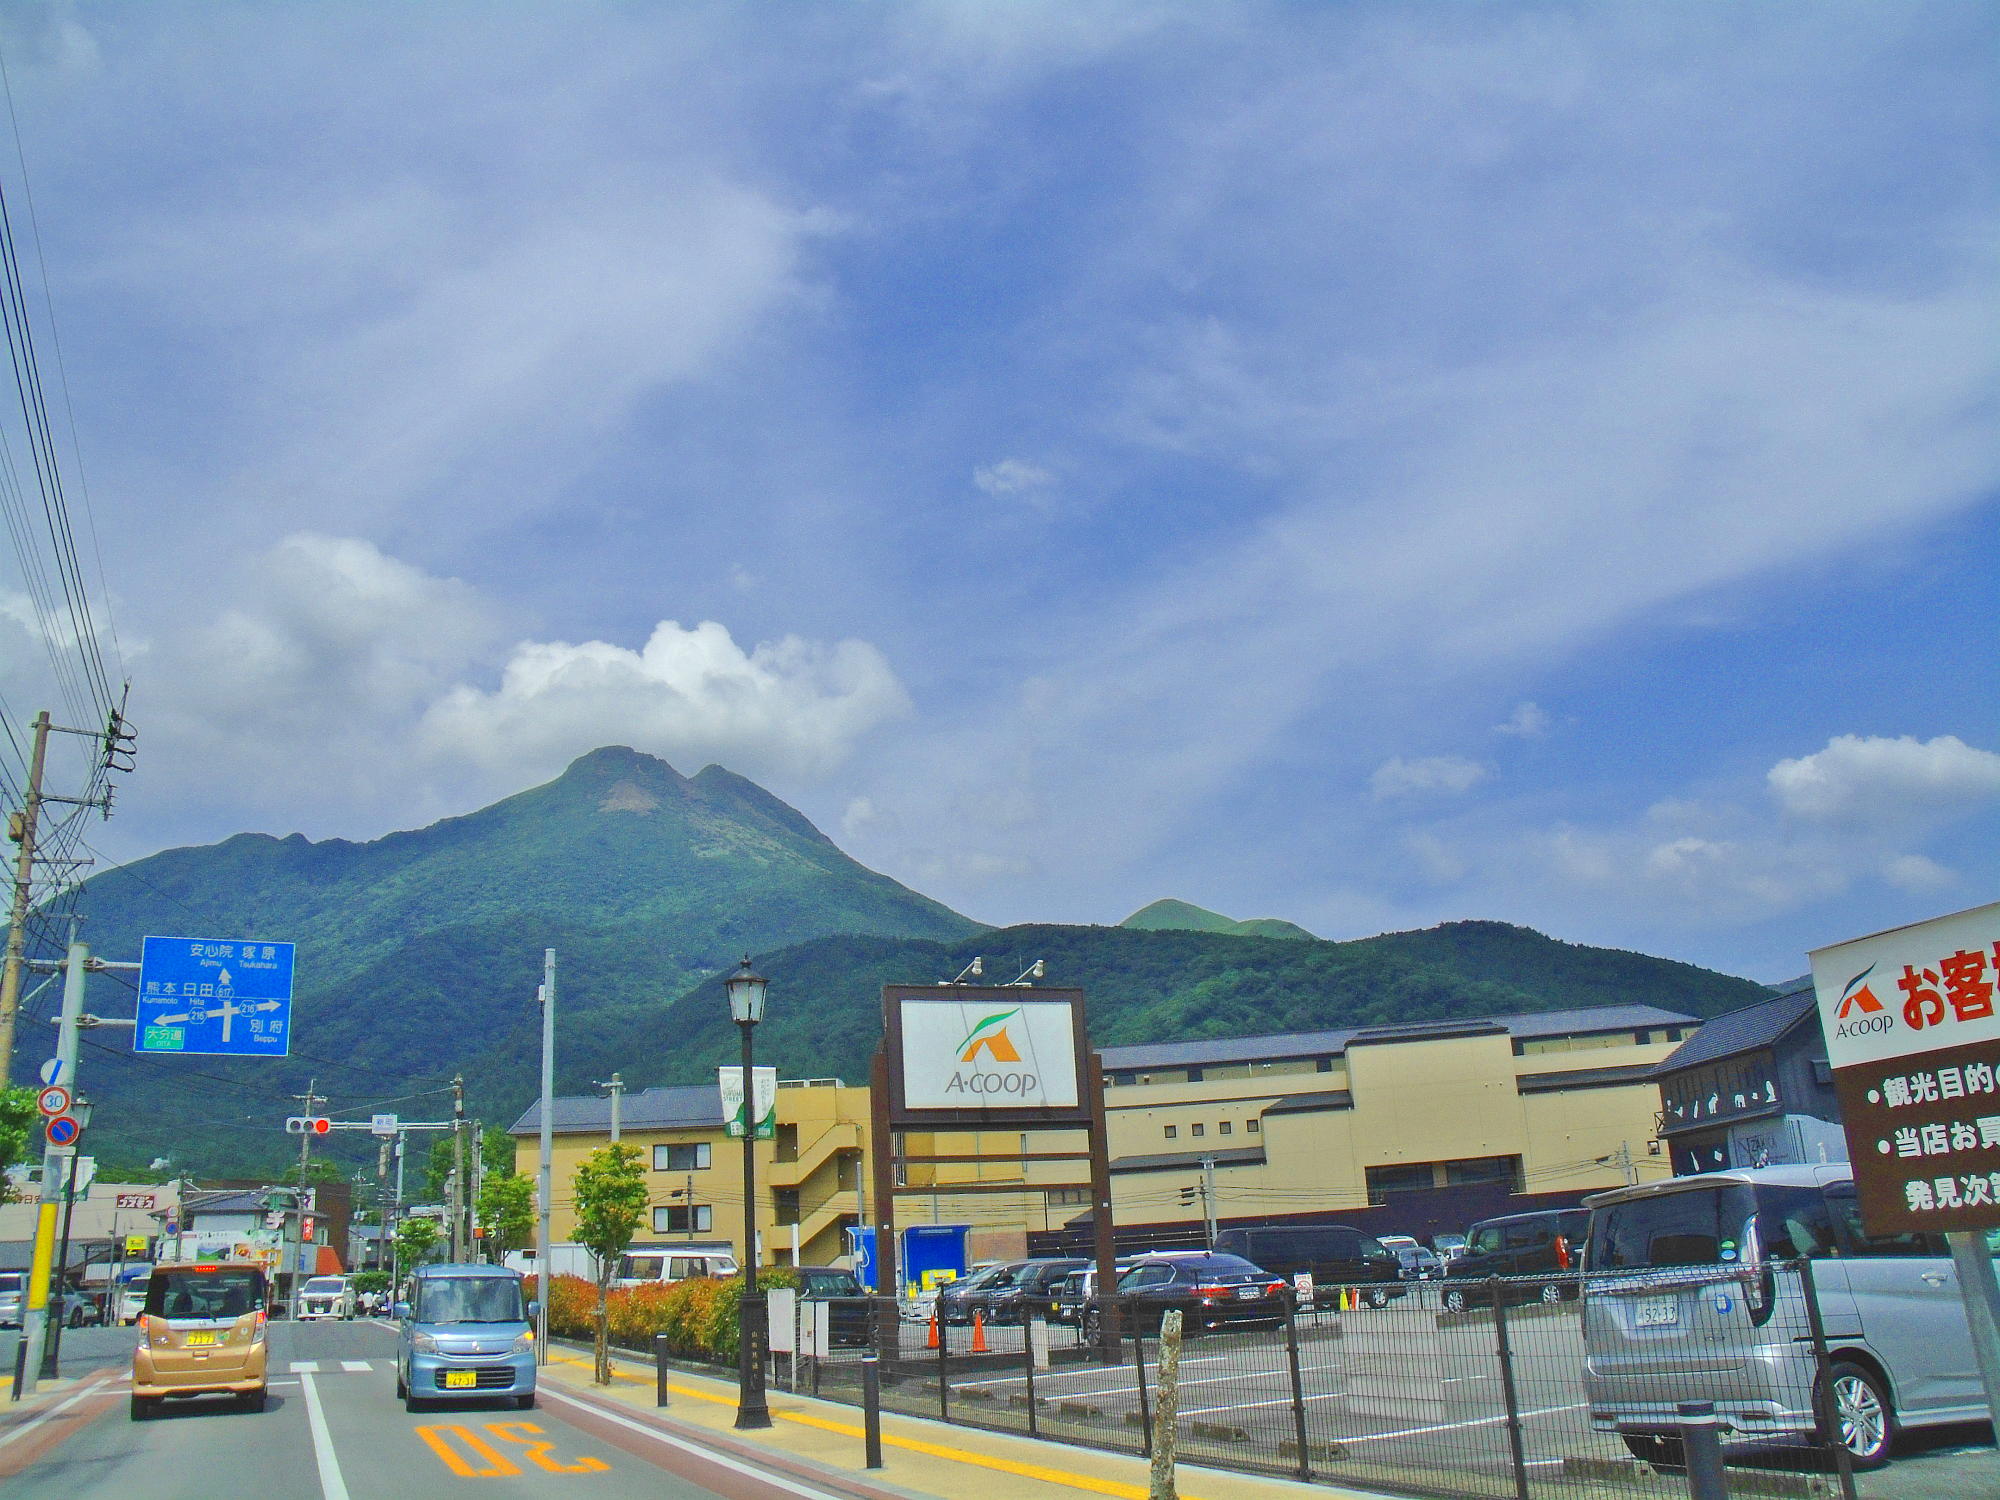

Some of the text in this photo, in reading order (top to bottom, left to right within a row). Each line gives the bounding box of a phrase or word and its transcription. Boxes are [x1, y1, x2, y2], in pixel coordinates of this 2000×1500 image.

[190, 944, 276, 960] 安心院 塚原
[200, 959, 278, 970] Ajimu Tsukahara
[146, 981, 214, 997] 熊本 日田
[1897, 940, 2000, 1031] お客
[142, 996, 205, 1006] Kumamoto Hita
[249, 1019, 283, 1034] 別府
[253, 1033, 277, 1043] Beppu
[1883, 1062, 2000, 1108] 観光目的
[45, 1095, 63, 1108] 30
